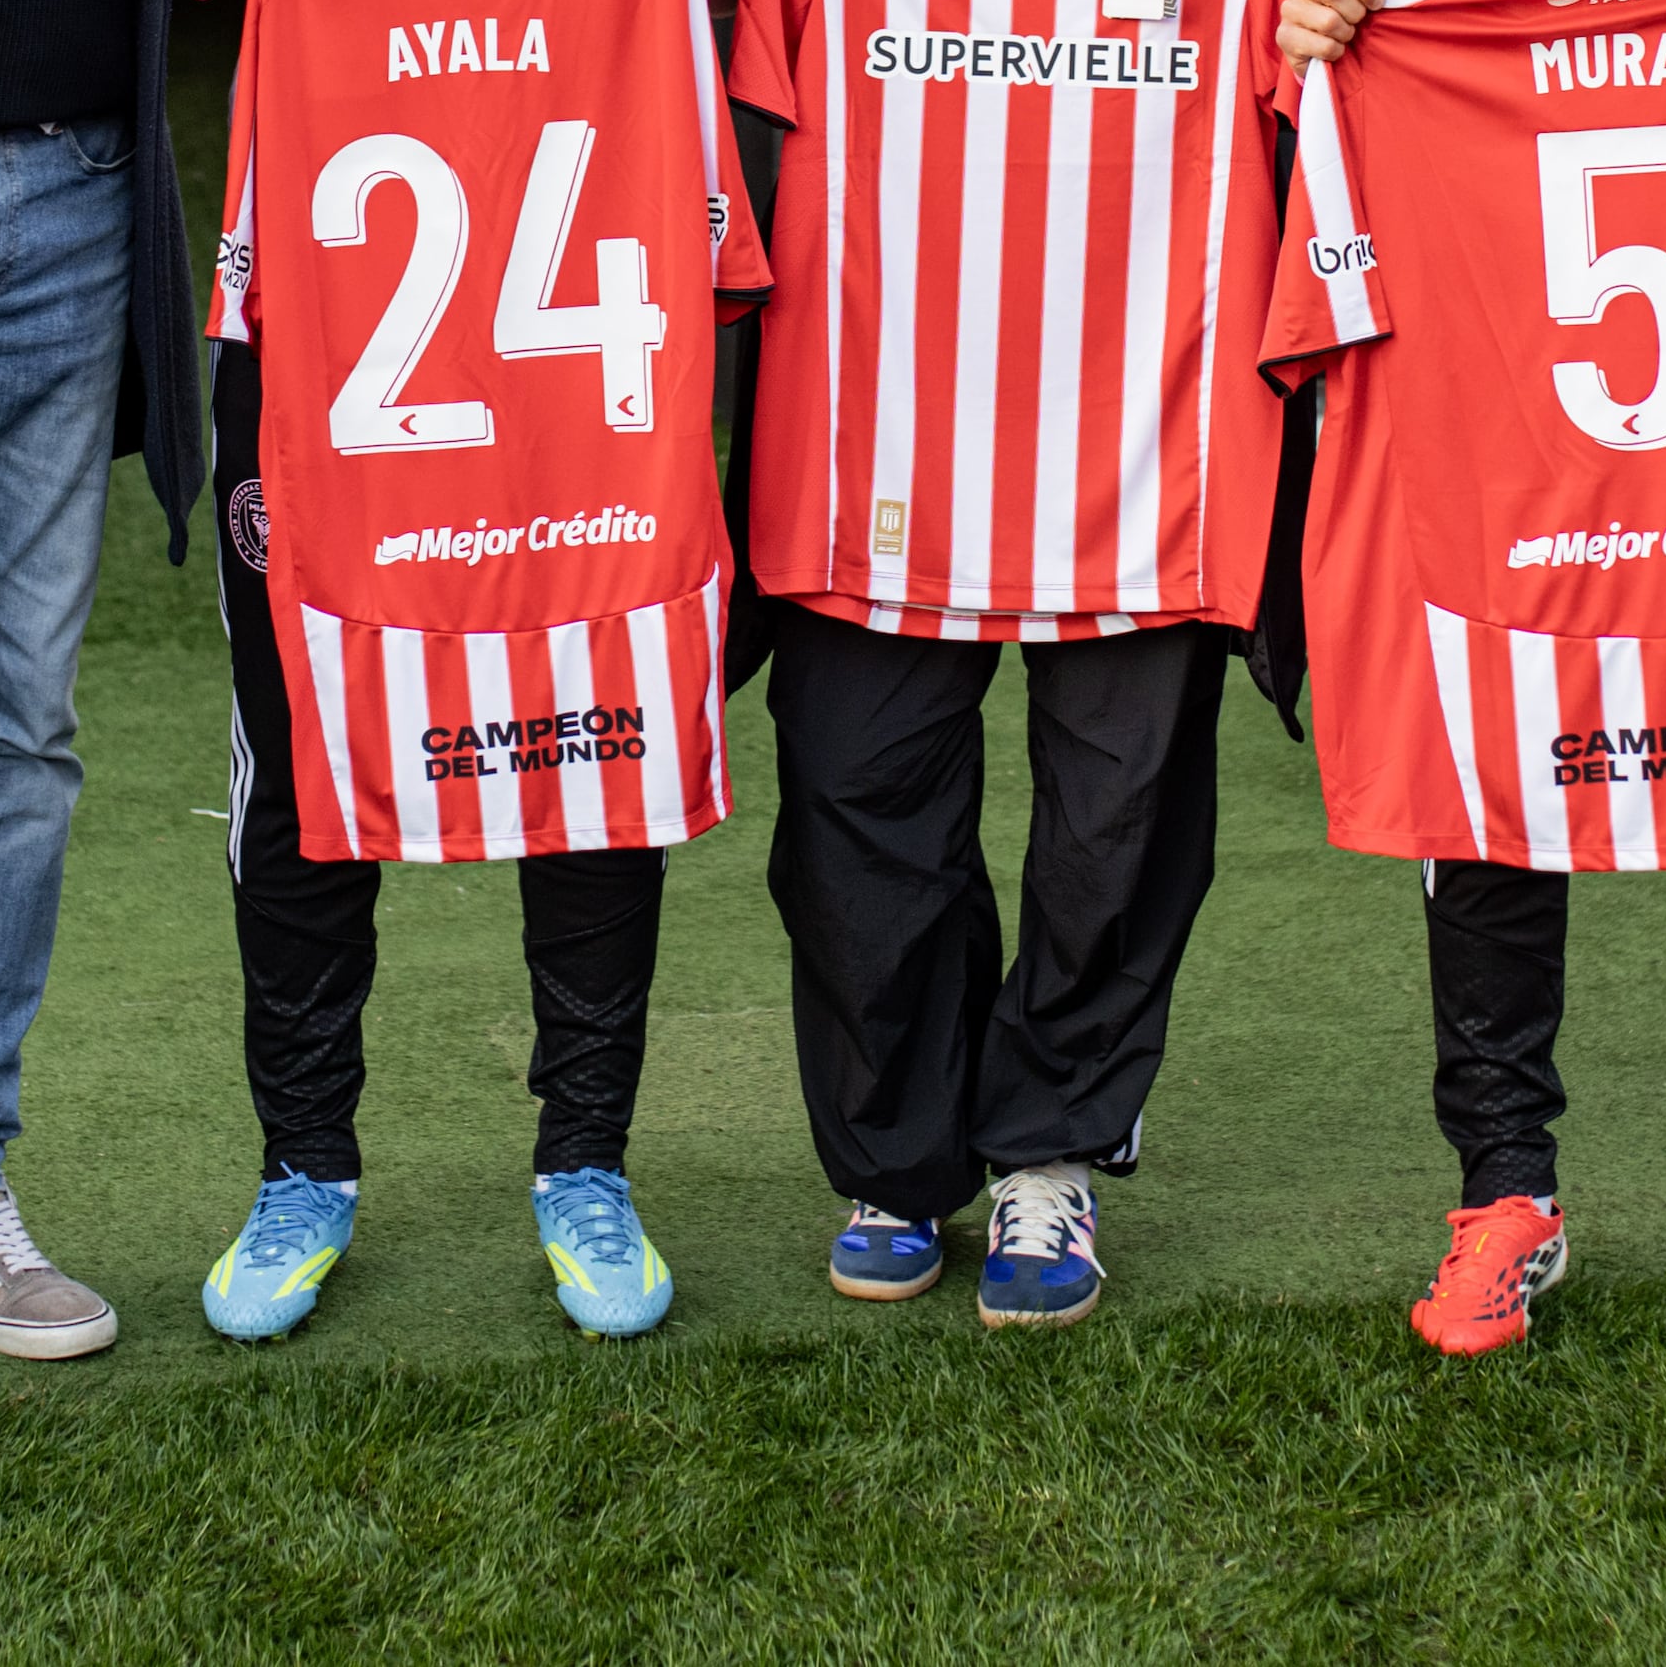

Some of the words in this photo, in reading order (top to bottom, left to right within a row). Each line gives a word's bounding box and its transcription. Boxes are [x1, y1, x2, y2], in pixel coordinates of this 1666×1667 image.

[387, 18, 550, 83] AYALA
[872, 35, 1193, 83] SUPERVIELLE
[311, 120, 667, 455] 24
[415, 519, 525, 567] Mejor
[528, 505, 657, 552] Crédito
[1551, 525, 1661, 572] Mejor
[421, 704, 645, 755] CAMPEÓN
[425, 750, 498, 781] DEL
[509, 736, 647, 775] MUNDO
[1553, 756, 1629, 787] DEL
